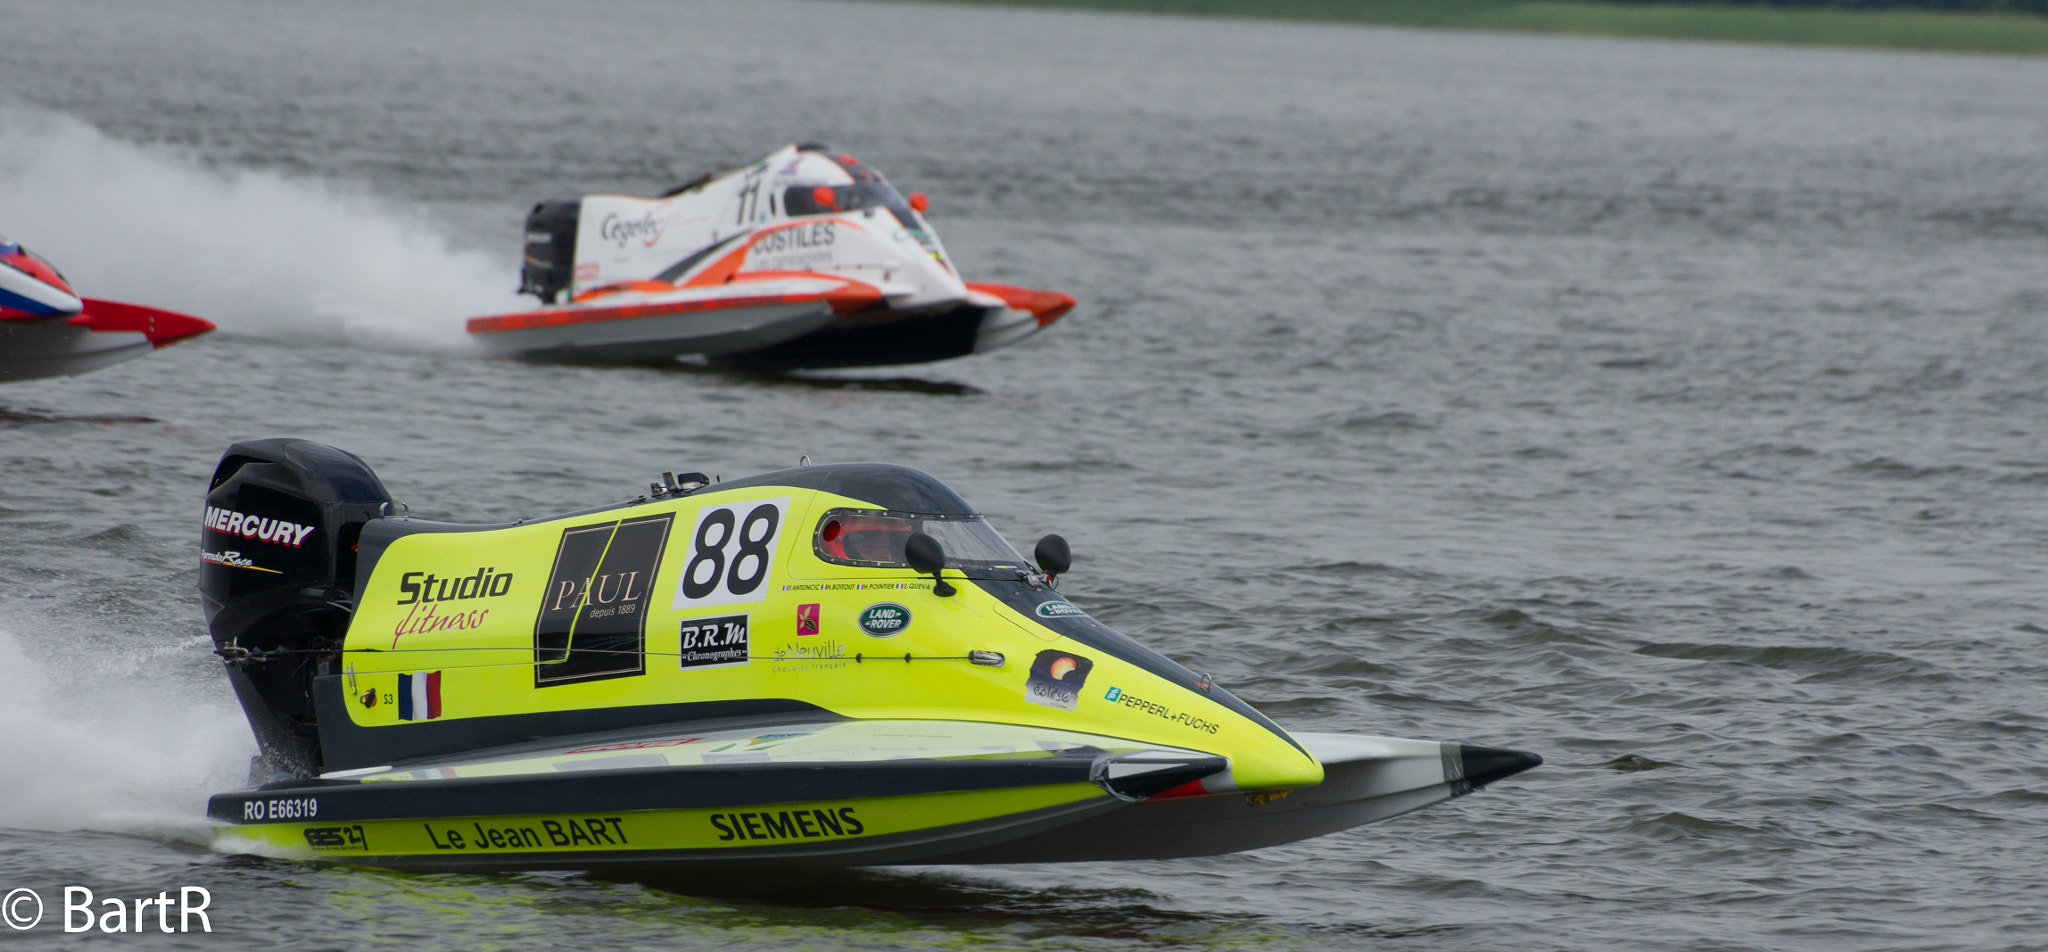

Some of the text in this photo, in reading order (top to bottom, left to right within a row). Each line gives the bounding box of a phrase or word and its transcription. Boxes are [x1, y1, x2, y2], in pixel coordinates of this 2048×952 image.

[738, 178, 761, 225] 11
[205, 506, 316, 547] MERCURY
[682, 503, 780, 599] 88
[397, 567, 513, 605] Studio
[552, 571, 642, 611] PAUL
[392, 600, 489, 650] fitness
[589, 604, 636, 619] depuis 1889
[869, 609, 896, 619] LAND
[870, 619, 902, 629] ROVER
[384, 693, 394, 705] S3
[1117, 693, 1220, 735] PEPPERL+FUCHS
[244, 798, 318, 821] RO E66319
[710, 807, 865, 841] SIEMENS
[424, 817, 629, 850] Le Jean BART
